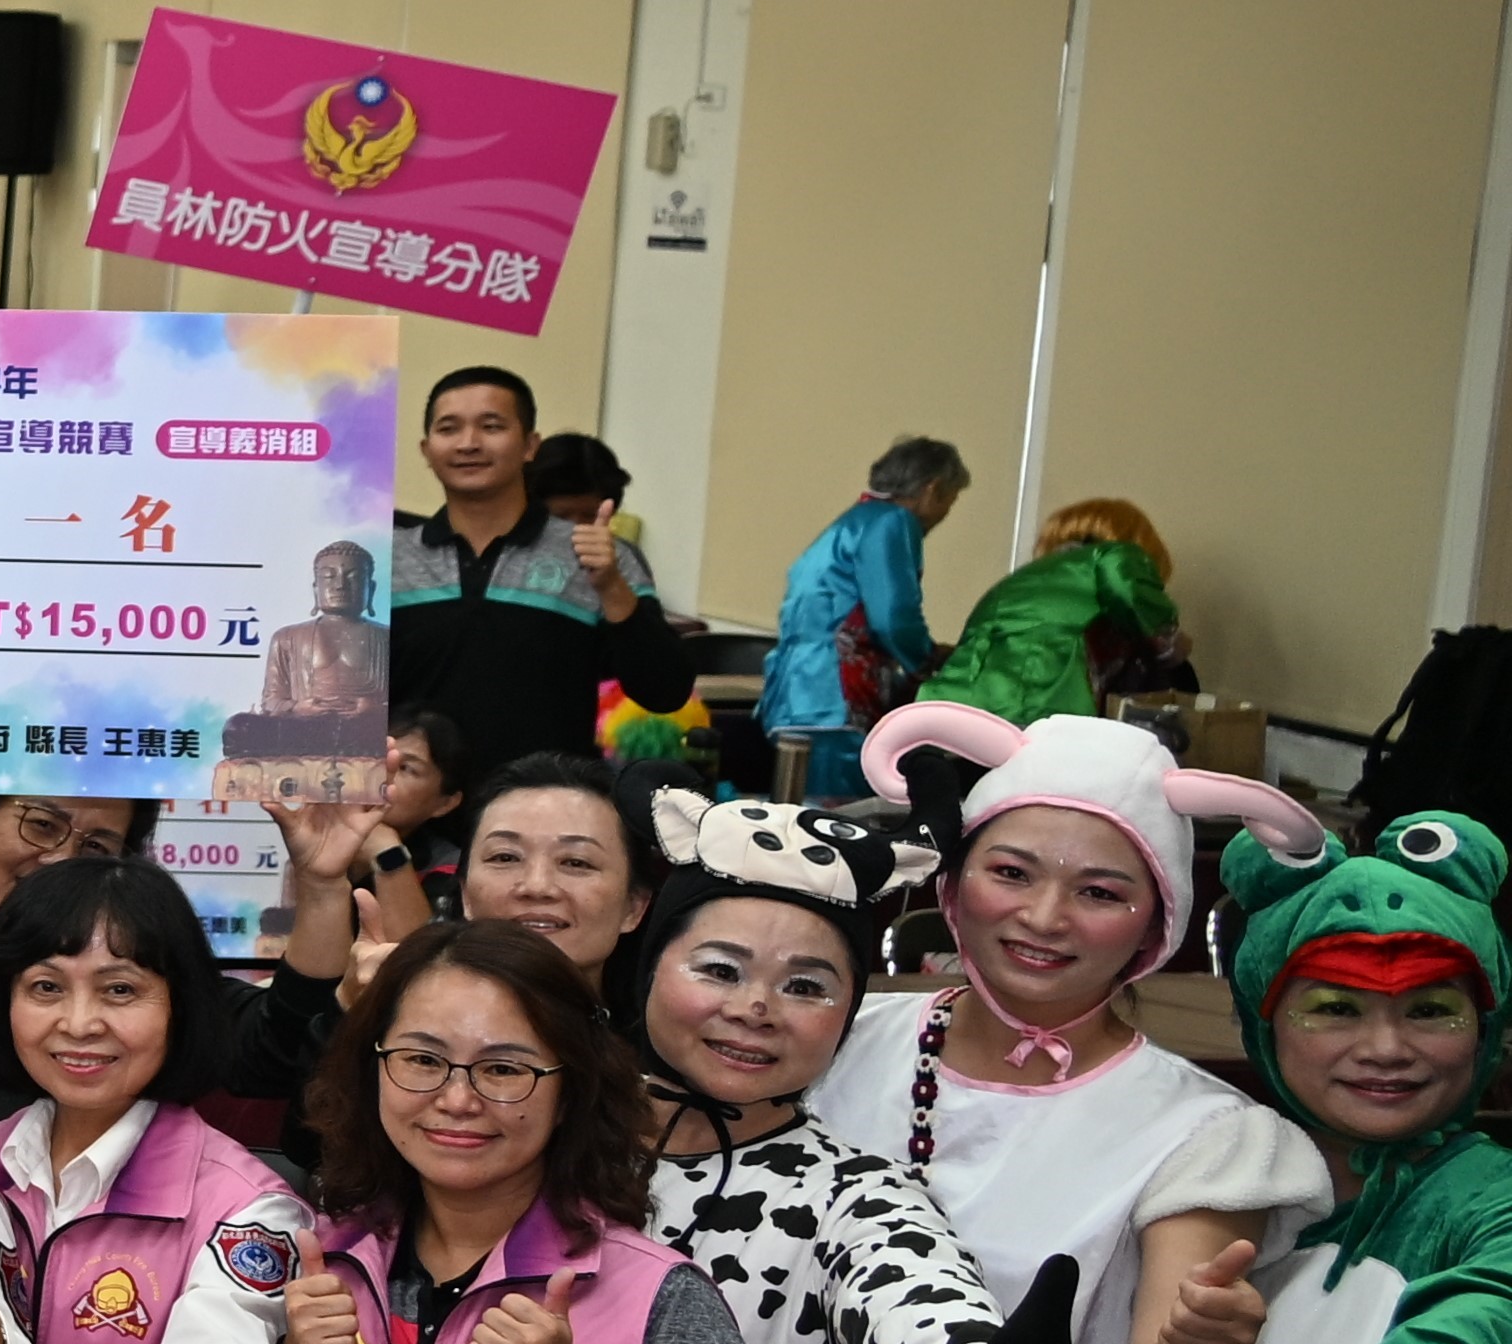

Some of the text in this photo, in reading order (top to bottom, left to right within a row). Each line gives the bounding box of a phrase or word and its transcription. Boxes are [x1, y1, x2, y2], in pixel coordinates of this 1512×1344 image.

[112, 178, 539, 304] 員林防火宣導分隊
[167, 428, 318, 457] 宣導義消組
[219, 610, 259, 647] 元
[25, 724, 87, 755] 縣長
[103, 727, 200, 758] 王惠美
[256, 845, 279, 868] 元
